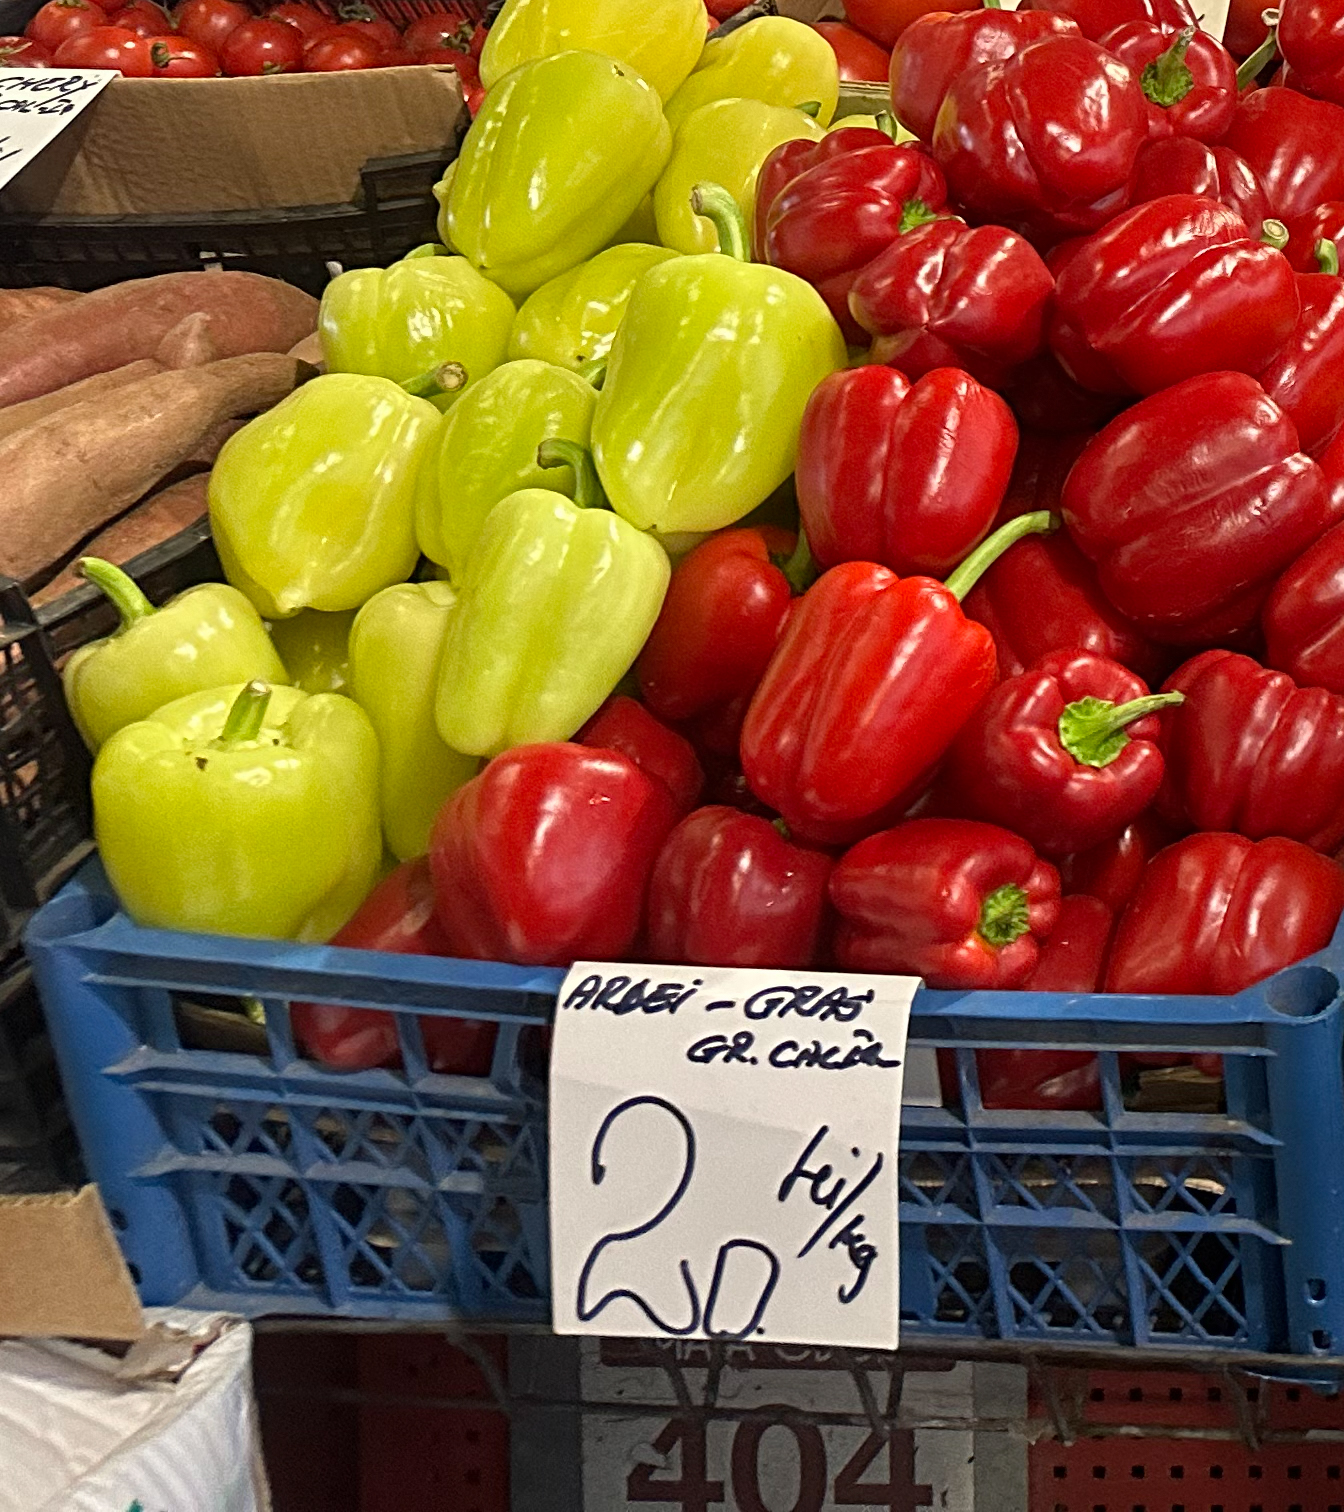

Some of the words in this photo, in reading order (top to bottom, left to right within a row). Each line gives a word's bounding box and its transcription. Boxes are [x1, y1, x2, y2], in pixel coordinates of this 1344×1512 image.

[563, 974, 704, 1016] ARDEI
[743, 985, 876, 1022] GRAS
[626, 1403, 934, 1512] 404
